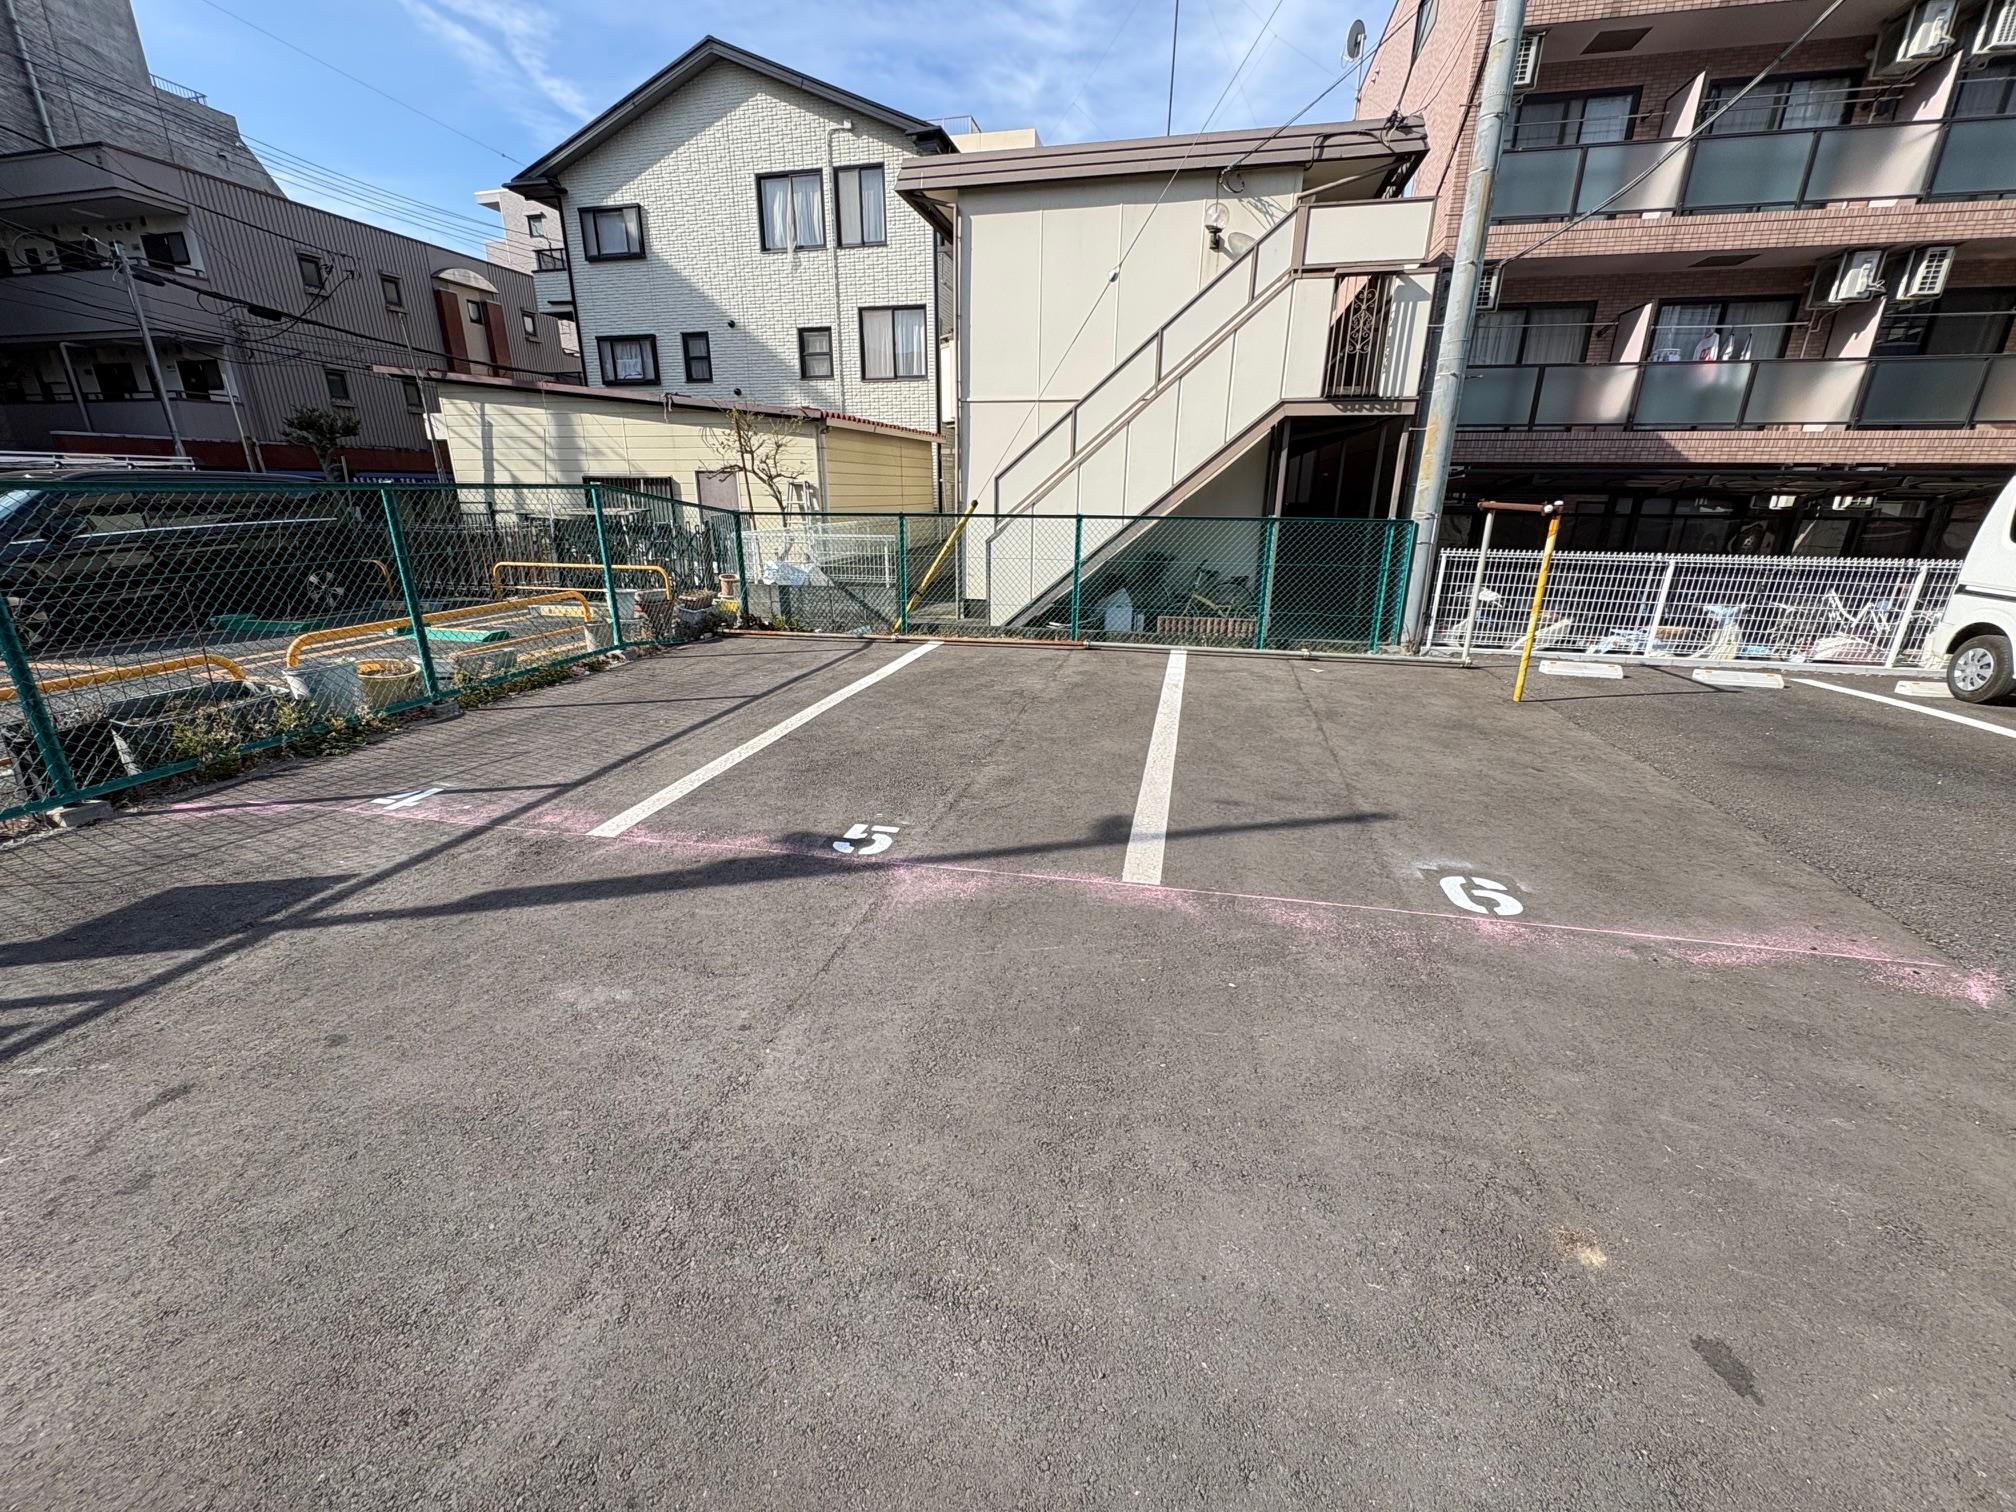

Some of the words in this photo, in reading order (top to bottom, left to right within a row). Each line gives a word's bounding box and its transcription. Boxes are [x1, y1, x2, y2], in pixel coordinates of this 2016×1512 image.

[370, 788, 445, 810] 4
[833, 824, 900, 854] 5
[1440, 876, 1523, 915] 6
